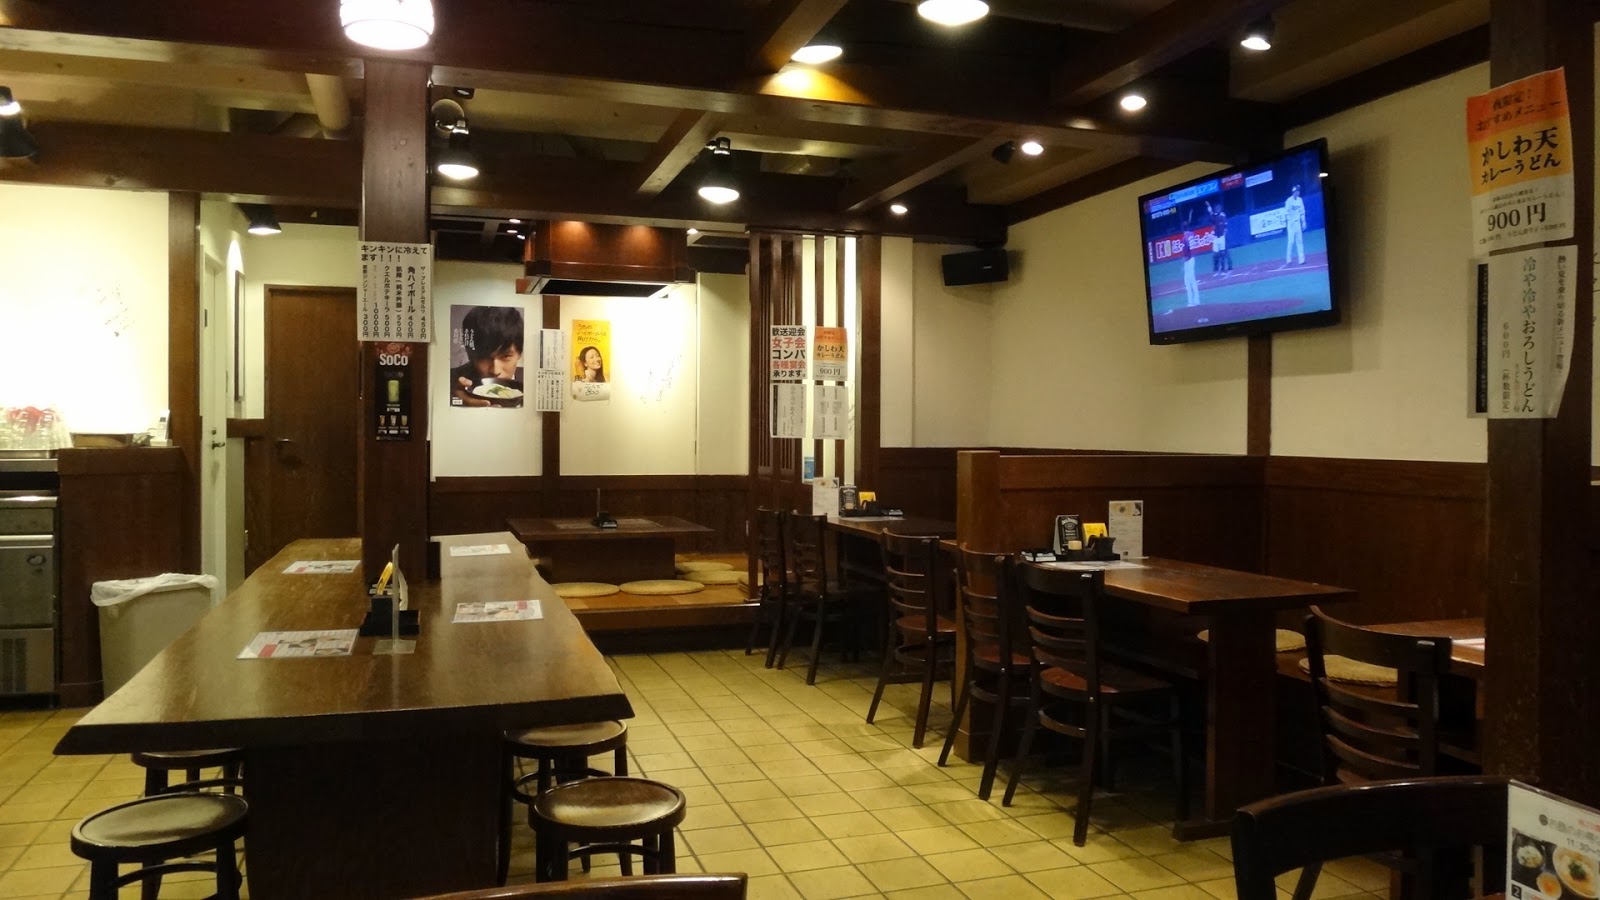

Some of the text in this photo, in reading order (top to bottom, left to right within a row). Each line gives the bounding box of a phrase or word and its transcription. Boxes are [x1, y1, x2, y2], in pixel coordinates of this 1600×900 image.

[1481, 127, 1559, 166] かしわ天
[1481, 153, 1561, 185] カレーうどん
[361, 245, 428, 255] キンキンに冷えて
[407, 266, 416, 313] 角ハイボール
[772, 327, 806, 337] 歓送迎会
[1522, 256, 1537, 413] 冷や冷やおろしうどん
[772, 337, 806, 348] 女子会
[772, 349, 806, 359] コンパ
[817, 344, 845, 353] かしわ天
[773, 369, 806, 378] 承ります。
[1513, 886, 1520, 897] 2
